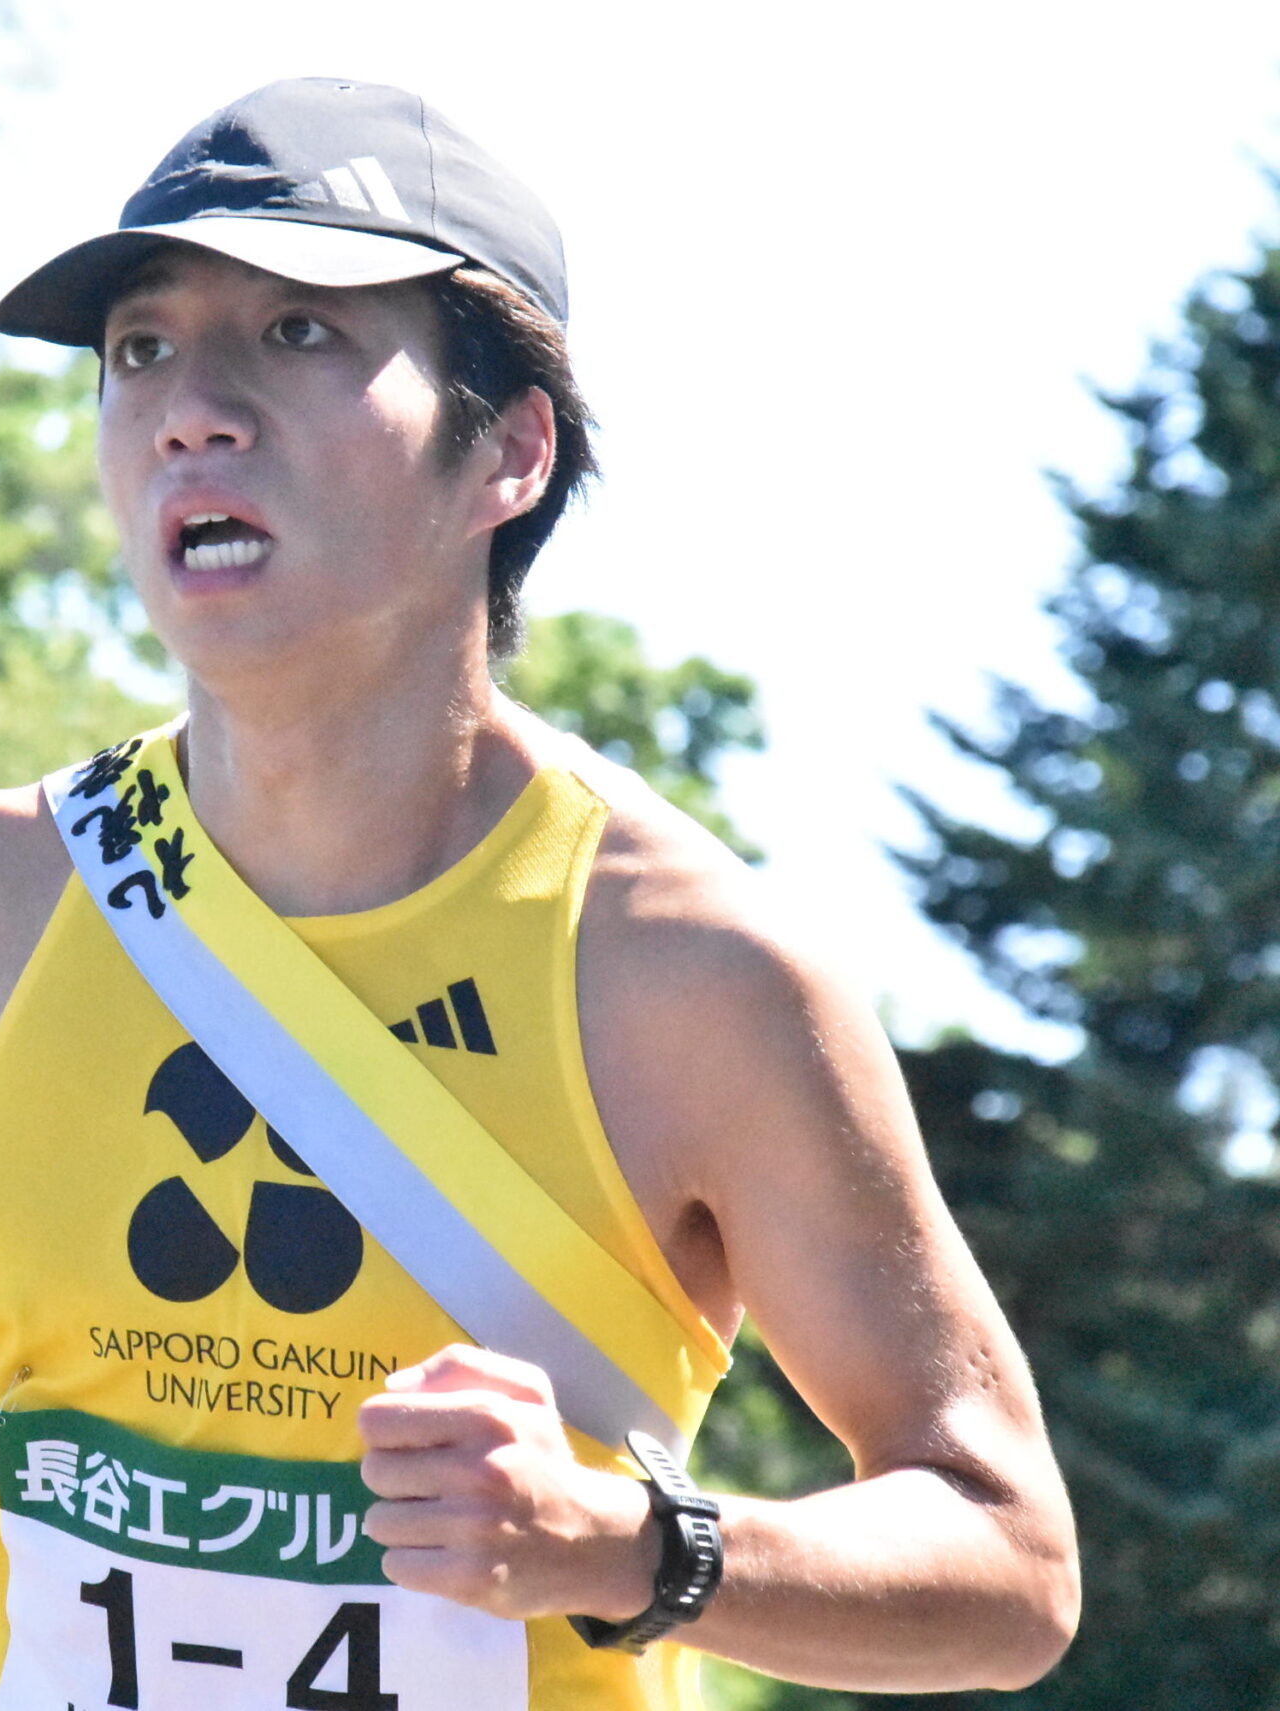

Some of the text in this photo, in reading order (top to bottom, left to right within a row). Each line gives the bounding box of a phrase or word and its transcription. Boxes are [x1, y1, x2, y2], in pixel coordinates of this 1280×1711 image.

[89, 1327, 397, 1381] SAPPORO GAKUIN
[146, 1370, 341, 1420] UNIVERSITY
[16, 1440, 368, 1565] 長谷工グル
[80, 1567, 399, 1711] 1-4
